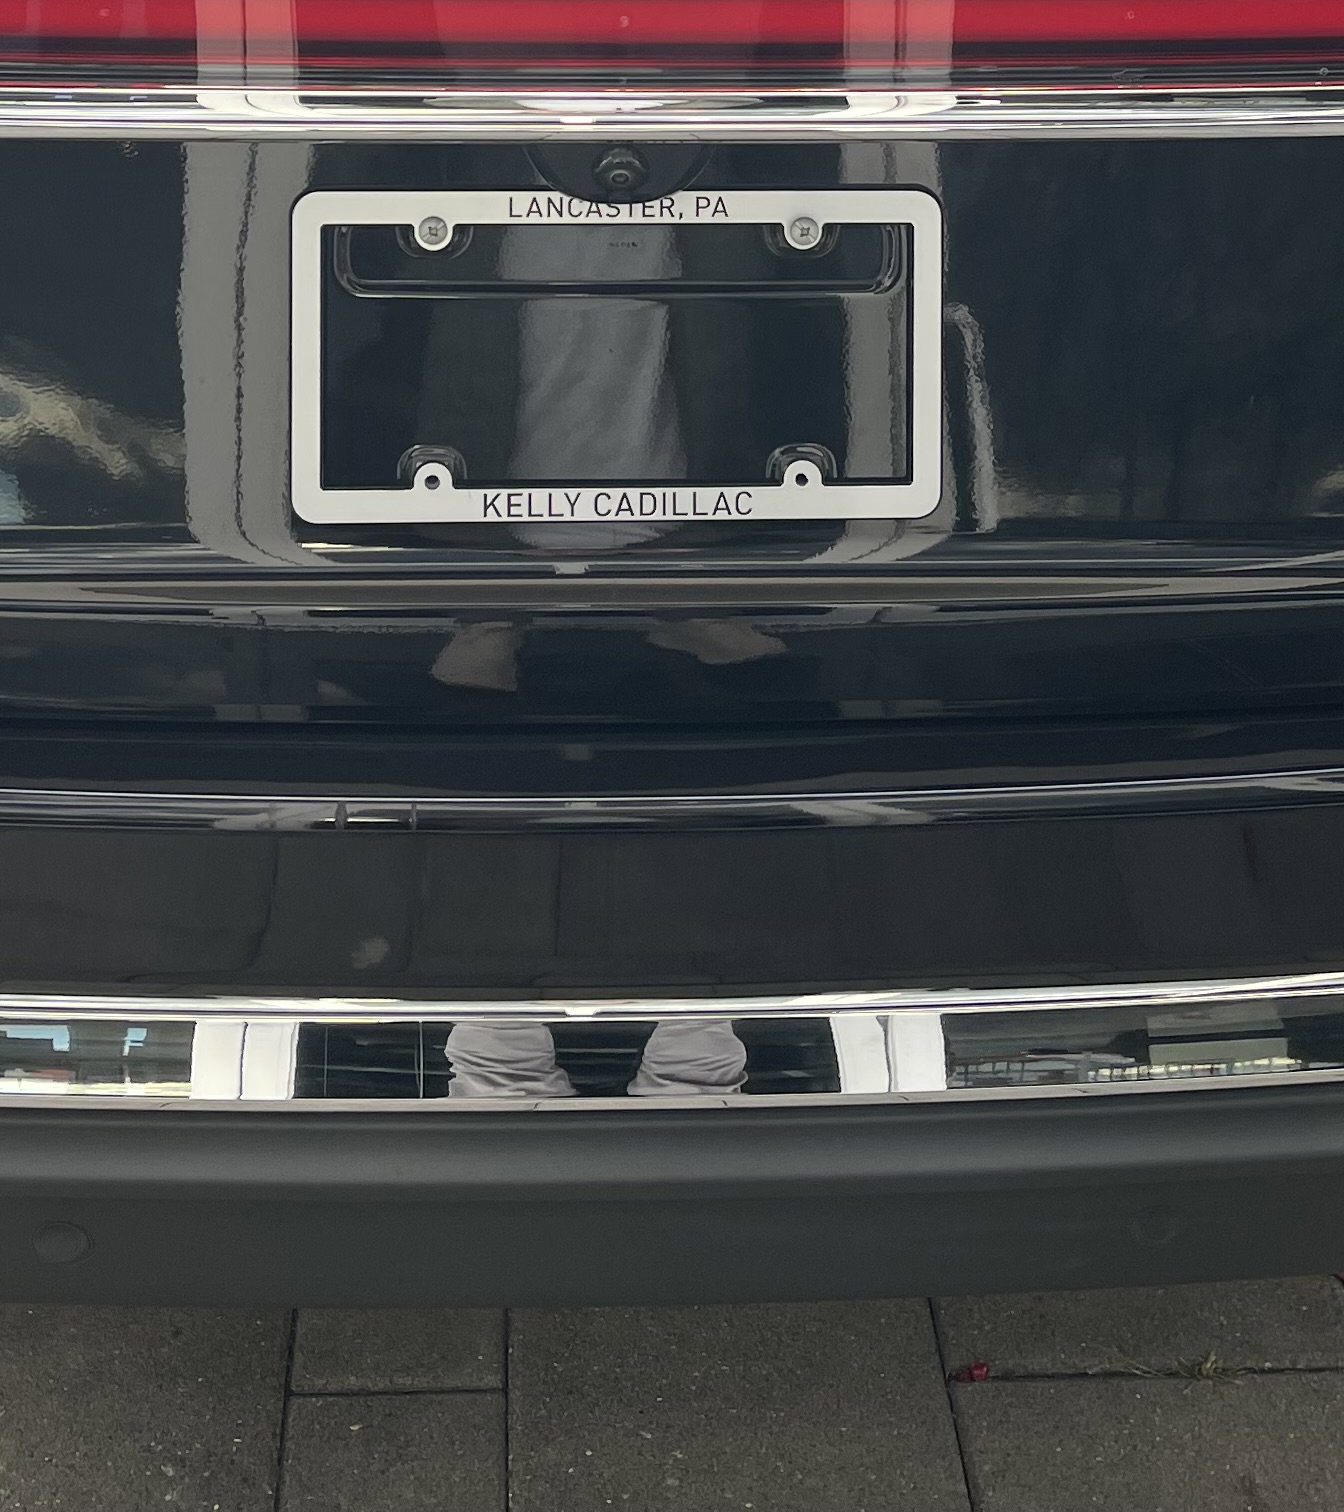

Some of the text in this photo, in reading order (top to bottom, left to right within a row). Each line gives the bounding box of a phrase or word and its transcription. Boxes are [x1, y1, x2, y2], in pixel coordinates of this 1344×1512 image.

[508, 196, 729, 220] LANCASTER, PA
[483, 491, 753, 518] KELLY CADILLAC
